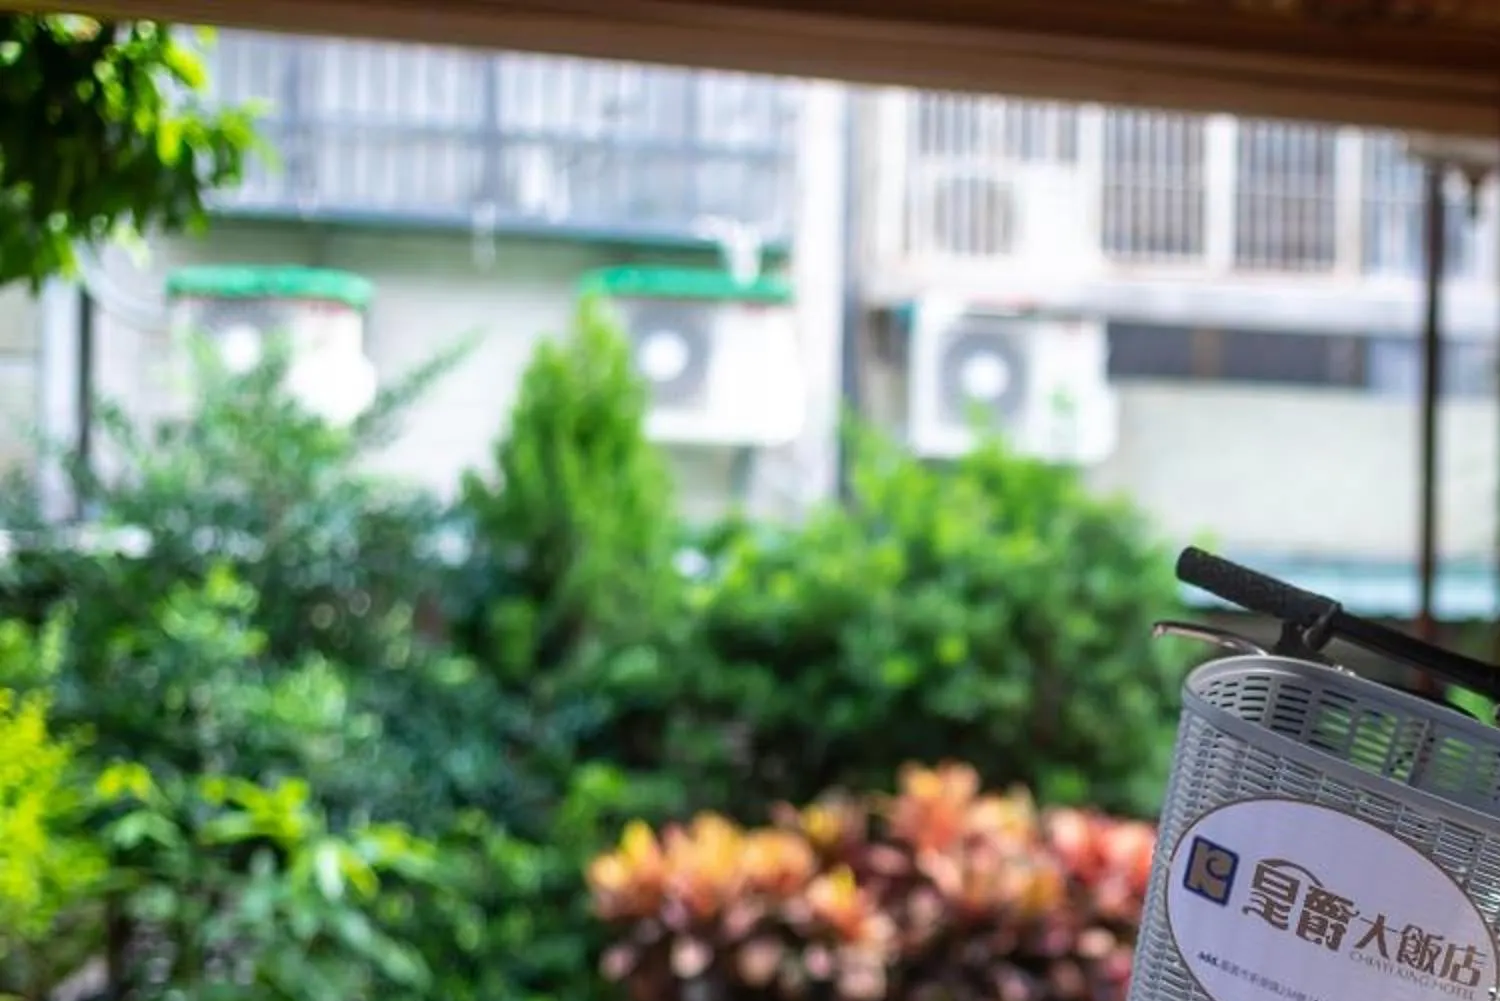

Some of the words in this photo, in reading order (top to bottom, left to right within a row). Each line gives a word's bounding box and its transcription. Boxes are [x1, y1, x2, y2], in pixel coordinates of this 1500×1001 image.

[1241, 858, 1487, 986] 皇爵大飯店
